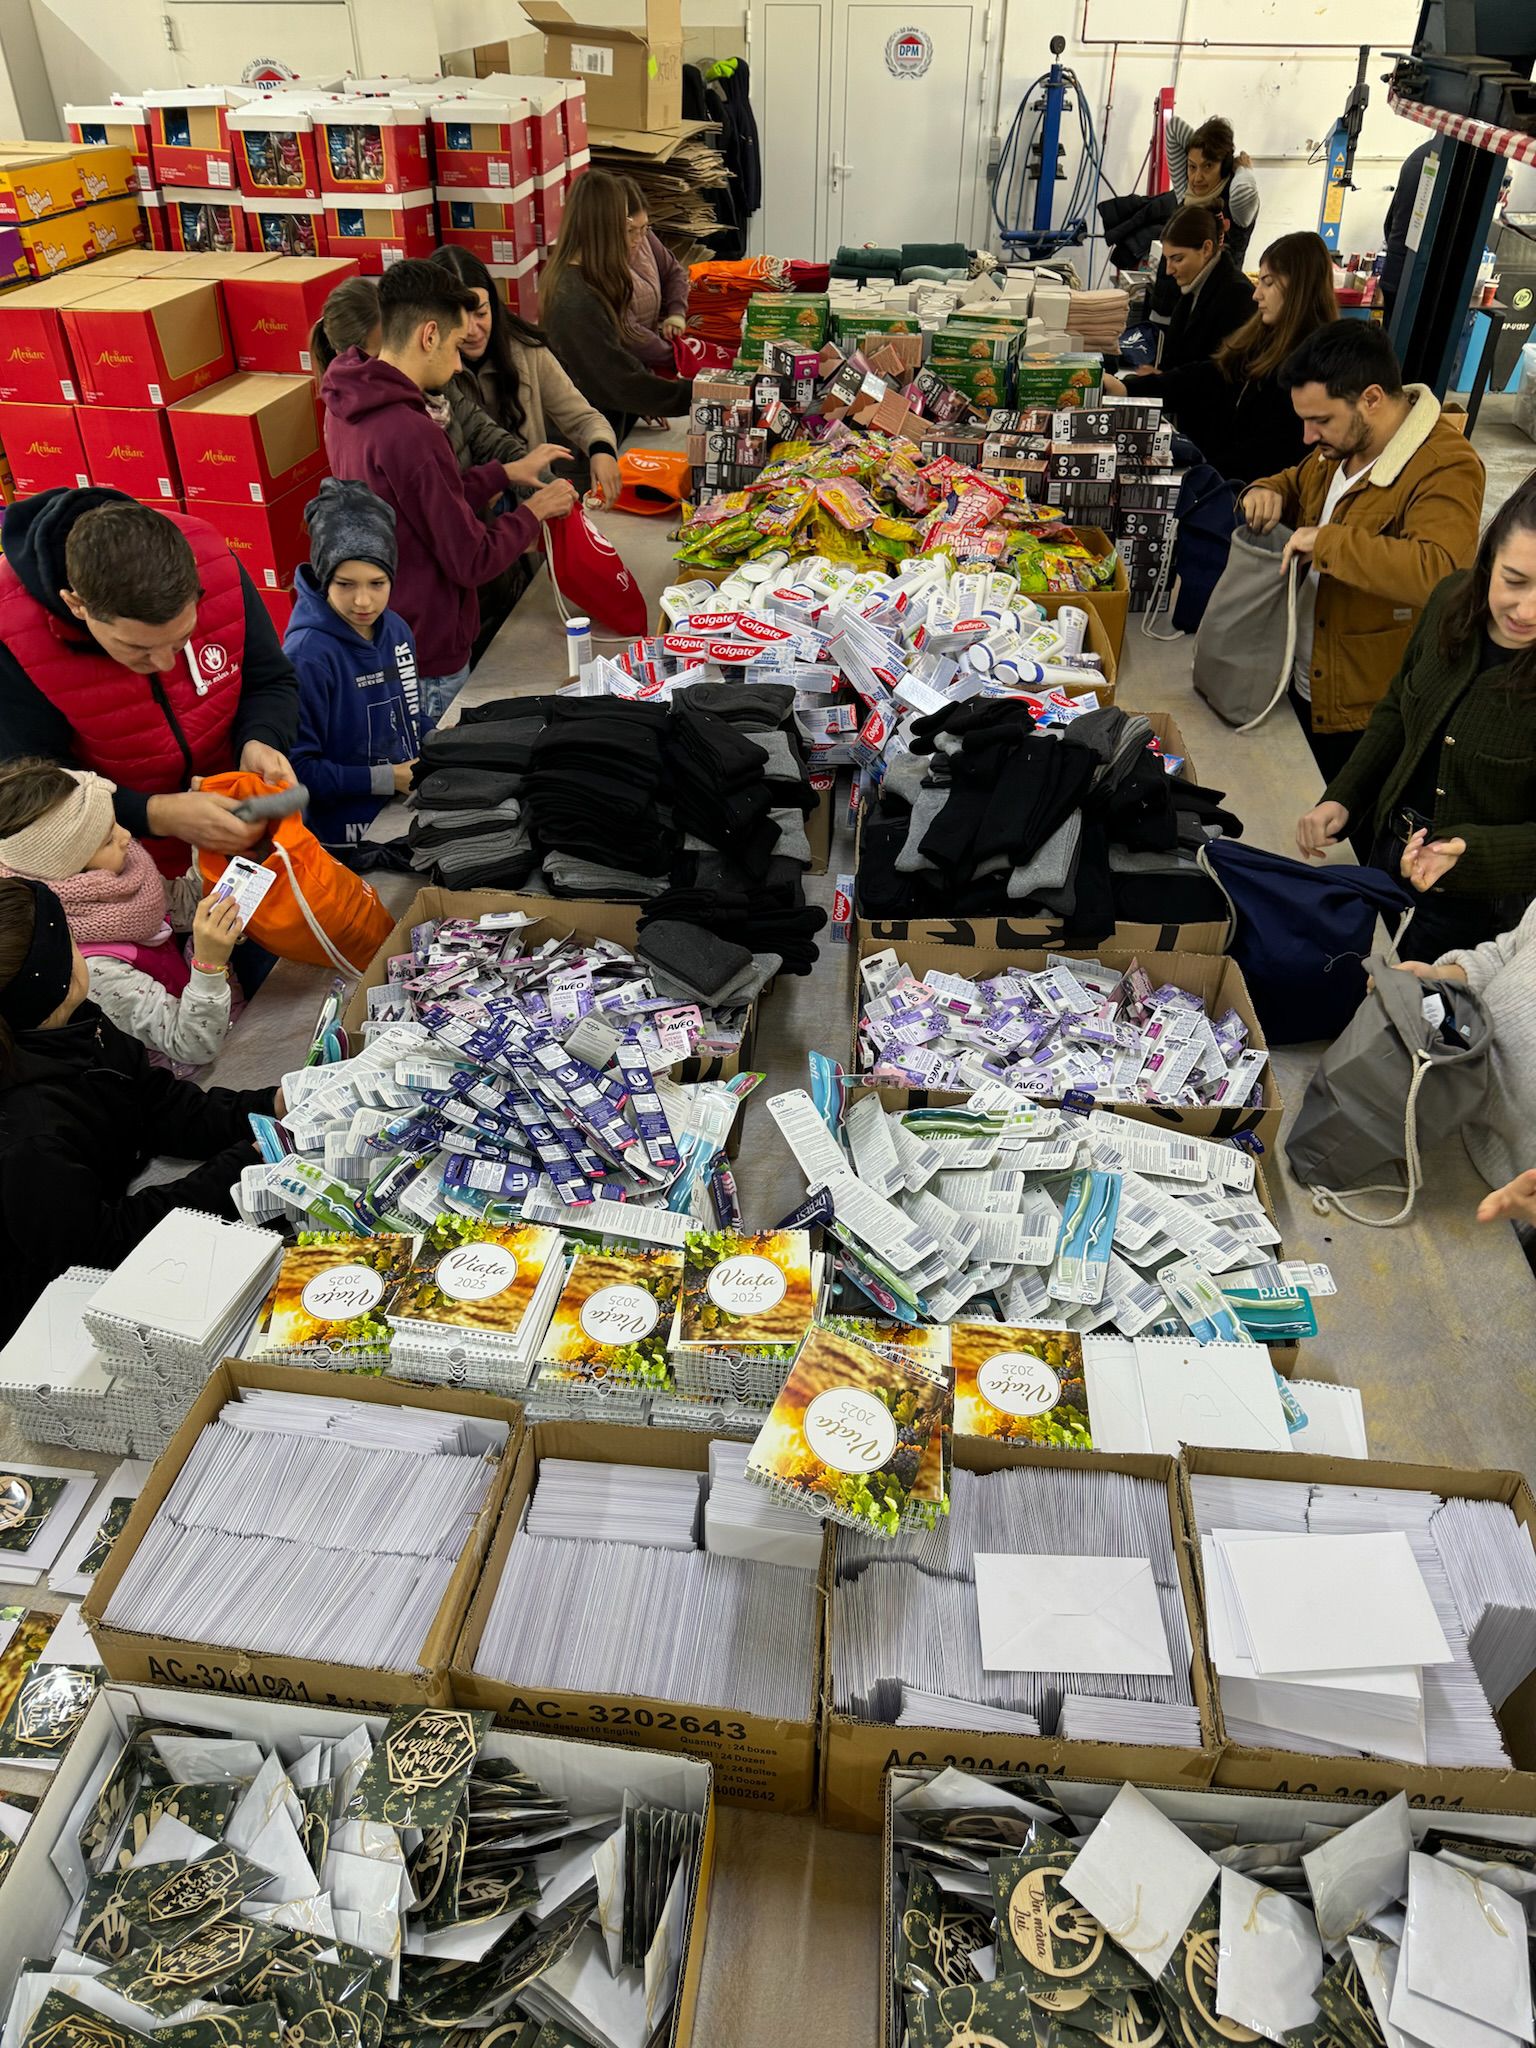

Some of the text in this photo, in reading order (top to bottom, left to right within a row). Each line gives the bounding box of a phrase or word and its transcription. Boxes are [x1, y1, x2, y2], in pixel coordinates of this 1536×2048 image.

[899, 45, 919, 56] DPM
[253, 58, 277, 67] 10 Jahre
[691, 614, 735, 627] Colgate
[740, 617, 783, 640] Colgate
[712, 644, 756, 659] Colgate
[1051, 692, 1075, 707] Colgate
[866, 718, 882, 740] Colgate
[834, 895, 847, 921] Colgate
[556, 982, 584, 991] AVEO
[902, 990, 920, 1003] AVEO
[666, 1020, 694, 1031] AVEO
[985, 1029, 1013, 1045] AVEO
[810, 1055, 819, 1081] soft
[928, 1059, 942, 1085] AVEO
[1014, 1081, 1045, 1091] AVEO
[1068, 1176, 1083, 1198] soft
[328, 1275, 361, 1287] 2025
[454, 1277, 487, 1290] 2025
[731, 1292, 763, 1303] 2025
[1258, 1286, 1299, 1299] hard
[609, 1295, 640, 1309] 2025
[1001, 1364, 1035, 1377] 2025
[840, 1401, 876, 1427] 2025
[508, 1697, 747, 1740] AC- 3202643
[603, 1726, 641, 1738] English
[680, 1735, 723, 1750] Quantity
[732, 1743, 745, 1753] 24
[747, 1746, 777, 1756] boxes
[720, 1752, 733, 1761] 24
[735, 1754, 766, 1765] Dozen
[730, 1763, 743, 1773] 24
[723, 1774, 734, 1783] 24
[1013, 1905, 1030, 1935] Lui
[1029, 1885, 1047, 1958] Din mâna
